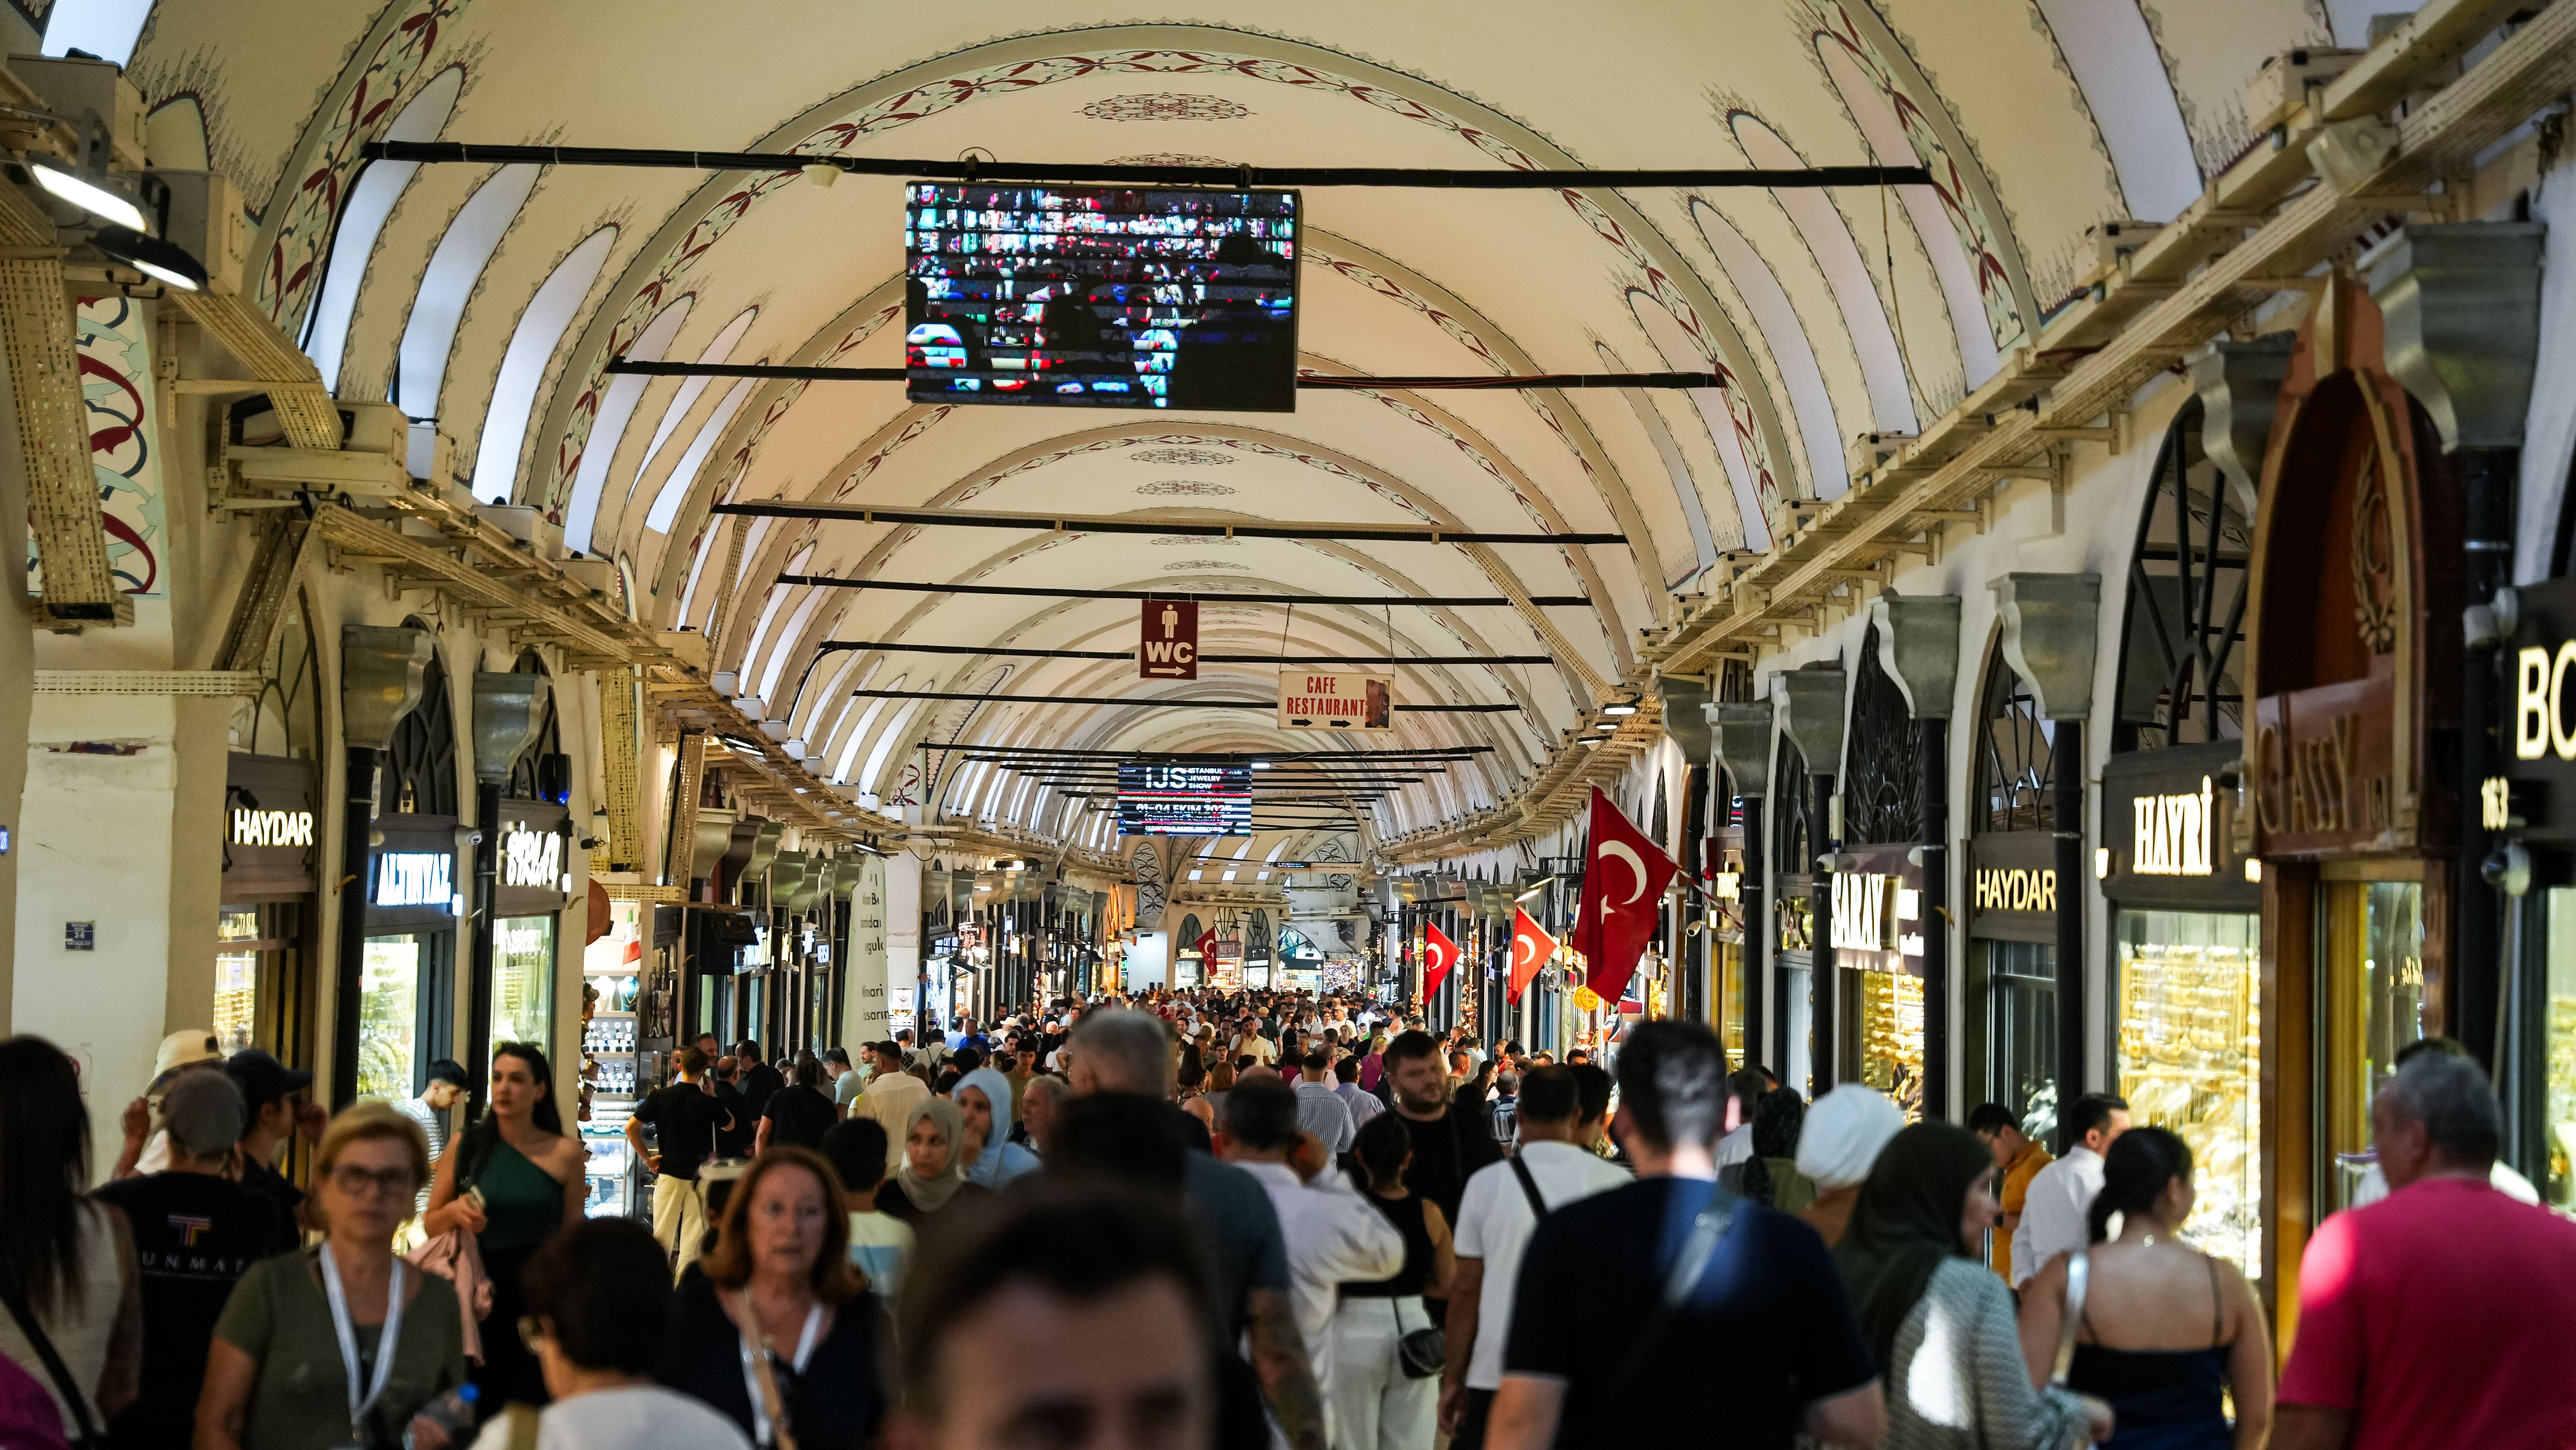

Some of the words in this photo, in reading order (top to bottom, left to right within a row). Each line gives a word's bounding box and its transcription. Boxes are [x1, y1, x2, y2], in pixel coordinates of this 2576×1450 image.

[1145, 641, 1193, 663] WC
[1307, 676, 1336, 694] CAFE
[1287, 697, 1365, 717] RESTAURANT
[2481, 776, 2508, 831] 163
[234, 809, 313, 846] HAYDAR
[2133, 775, 2212, 875] HAYRİ
[1976, 869, 2056, 911] HAYDAR
[1831, 872, 1886, 952] SARAY
